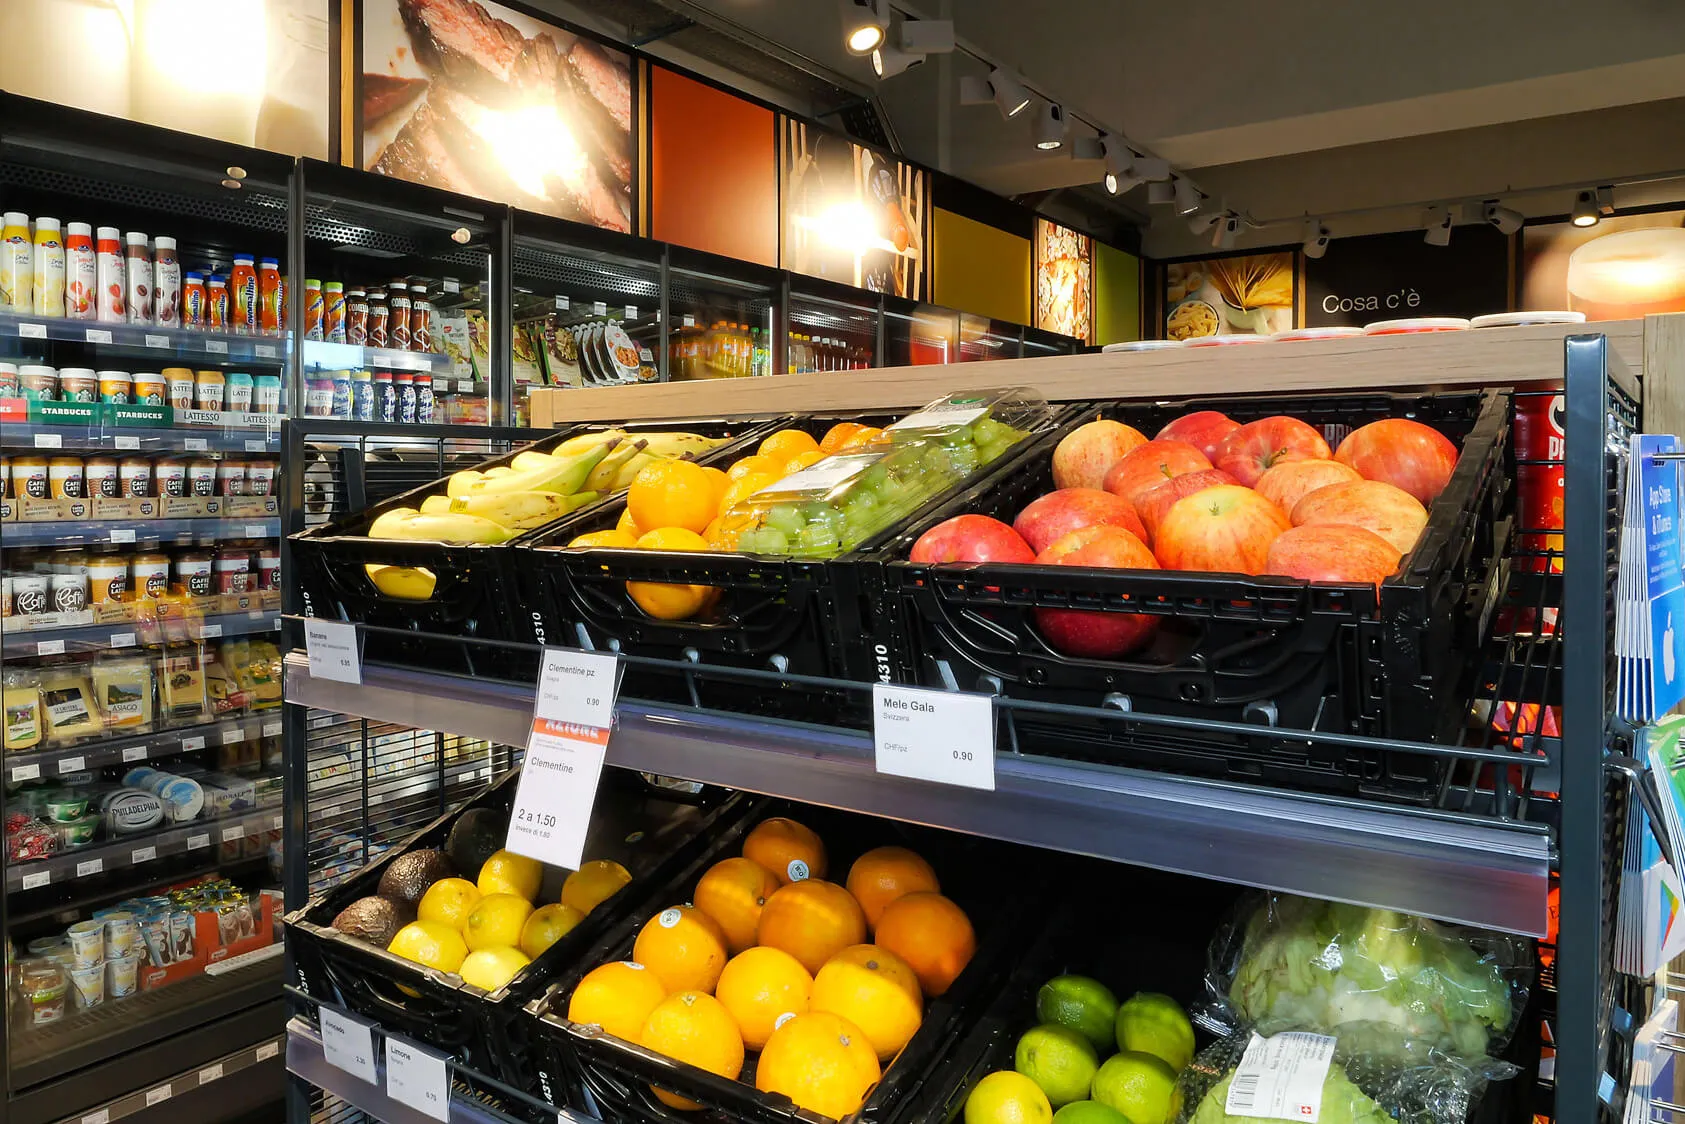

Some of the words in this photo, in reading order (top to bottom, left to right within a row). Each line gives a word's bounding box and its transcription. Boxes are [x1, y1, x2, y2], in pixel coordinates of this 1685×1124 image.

[1322, 294, 1380, 314] Cosa
[41, 407, 92, 416] STARBUCKS
[116, 411, 163, 420] STARBUCKS
[184, 411, 220, 422] LATTESSO
[548, 663, 585, 676] Clementine
[874, 644, 891, 684] 4310
[112, 703, 138, 712] ASIAGO
[586, 697, 600, 706] 0.90
[883, 698, 908, 710] Mele
[910, 700, 935, 713] Gala
[952, 750, 973, 761] 0.90
[531, 756, 574, 774] Clementine
[111, 801, 160, 816] PHILADELPHIA
[518, 808, 525, 820] 2
[526, 812, 533, 822] a
[537, 812, 556, 827] 1.50
